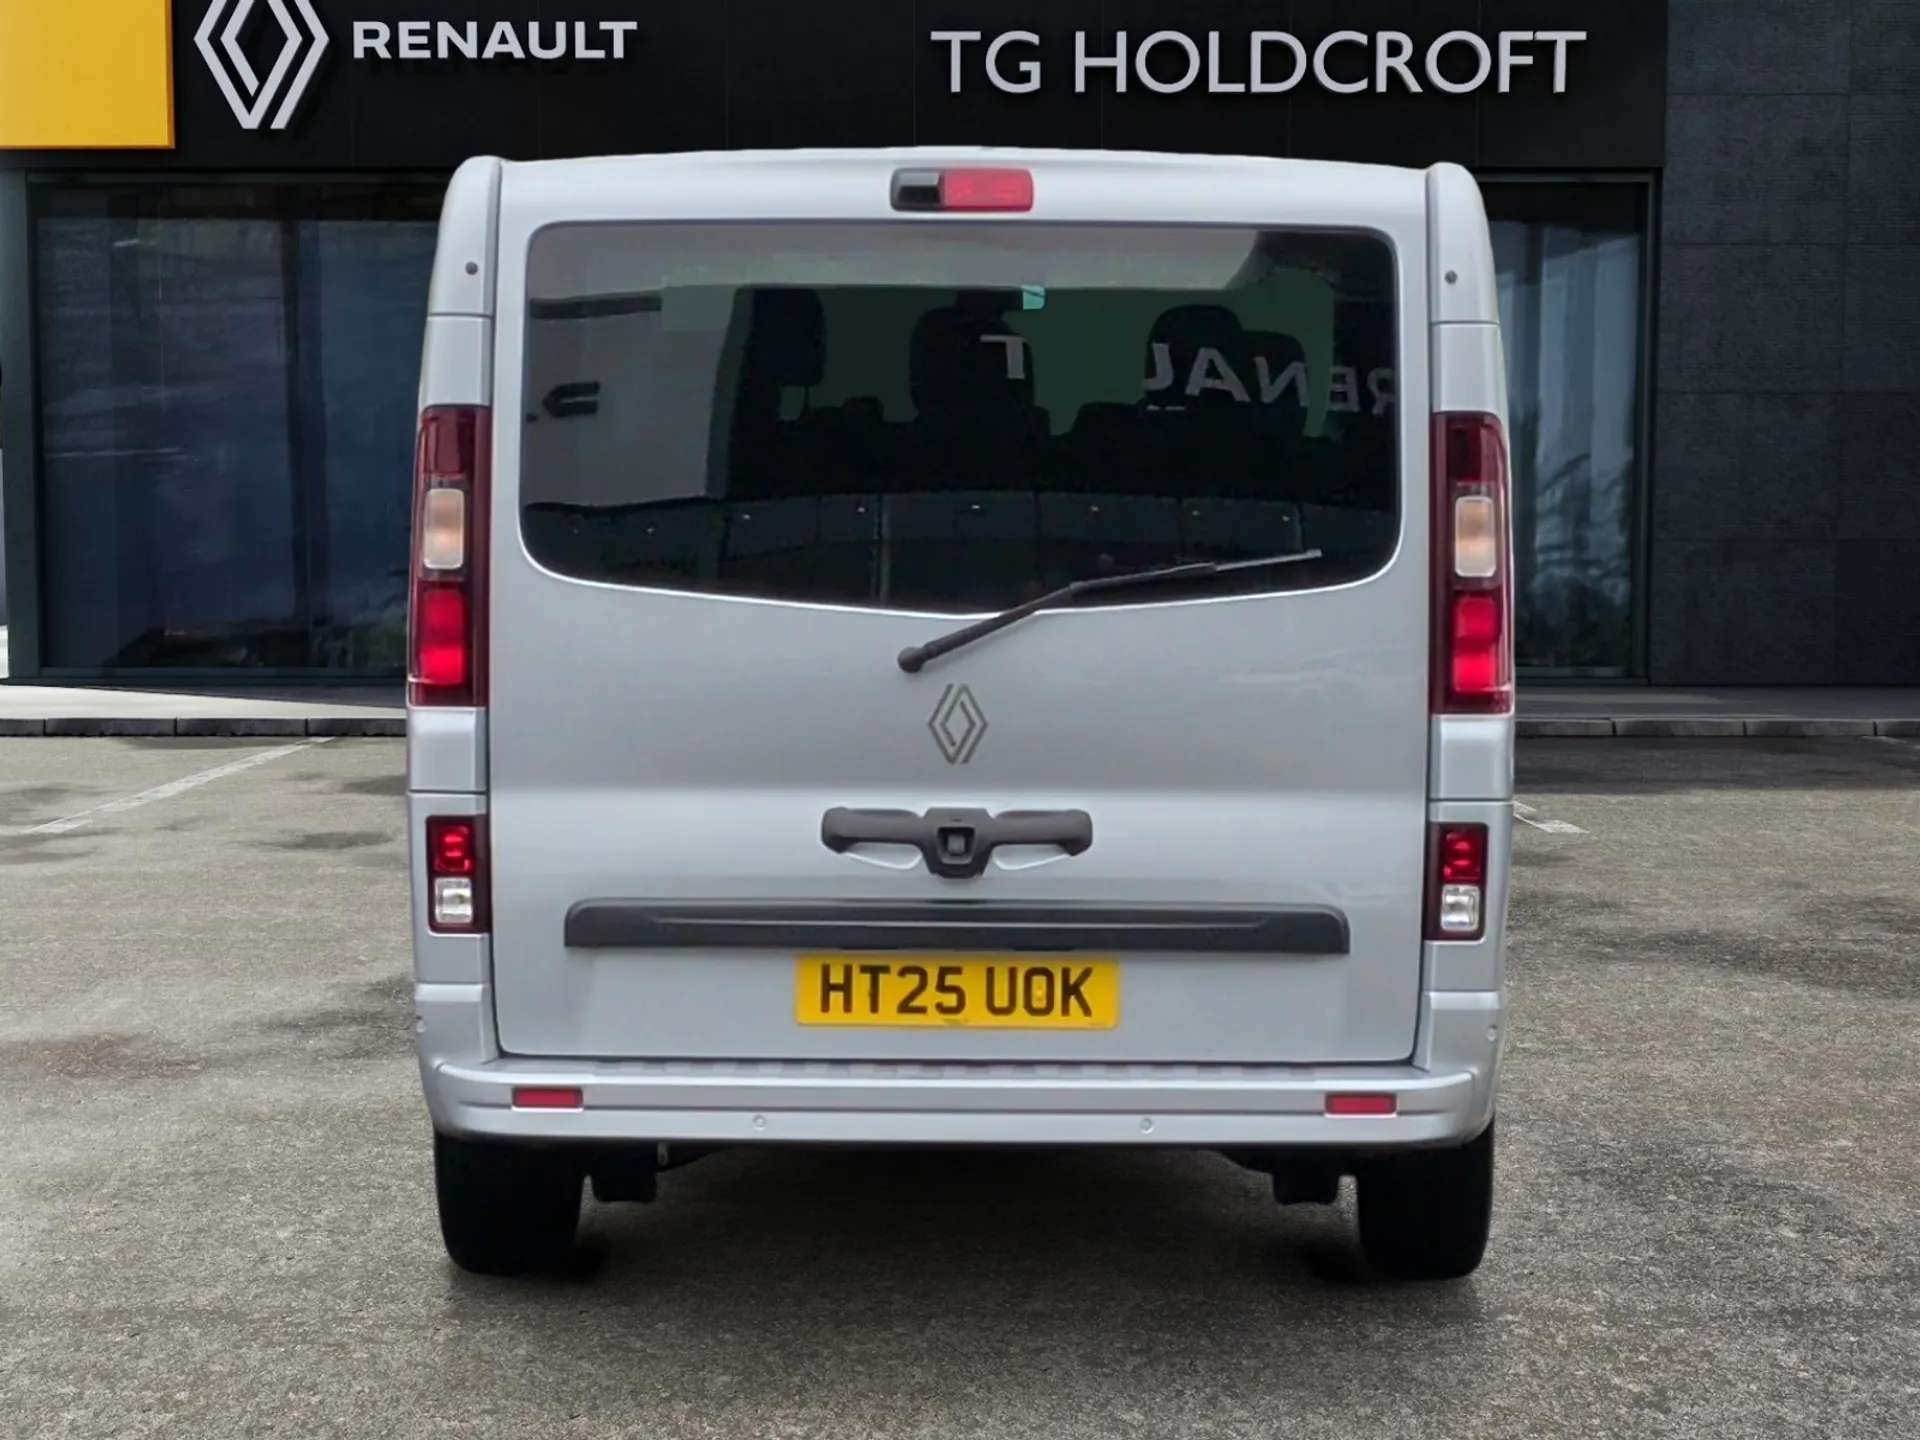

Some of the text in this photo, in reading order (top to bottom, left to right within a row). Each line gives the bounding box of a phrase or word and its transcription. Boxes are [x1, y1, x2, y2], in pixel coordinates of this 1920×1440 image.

[353, 21, 637, 59] RENAULT
[930, 30, 1586, 93] TG HOLDCROFT
[819, 963, 1094, 1018] HT25 UOK
